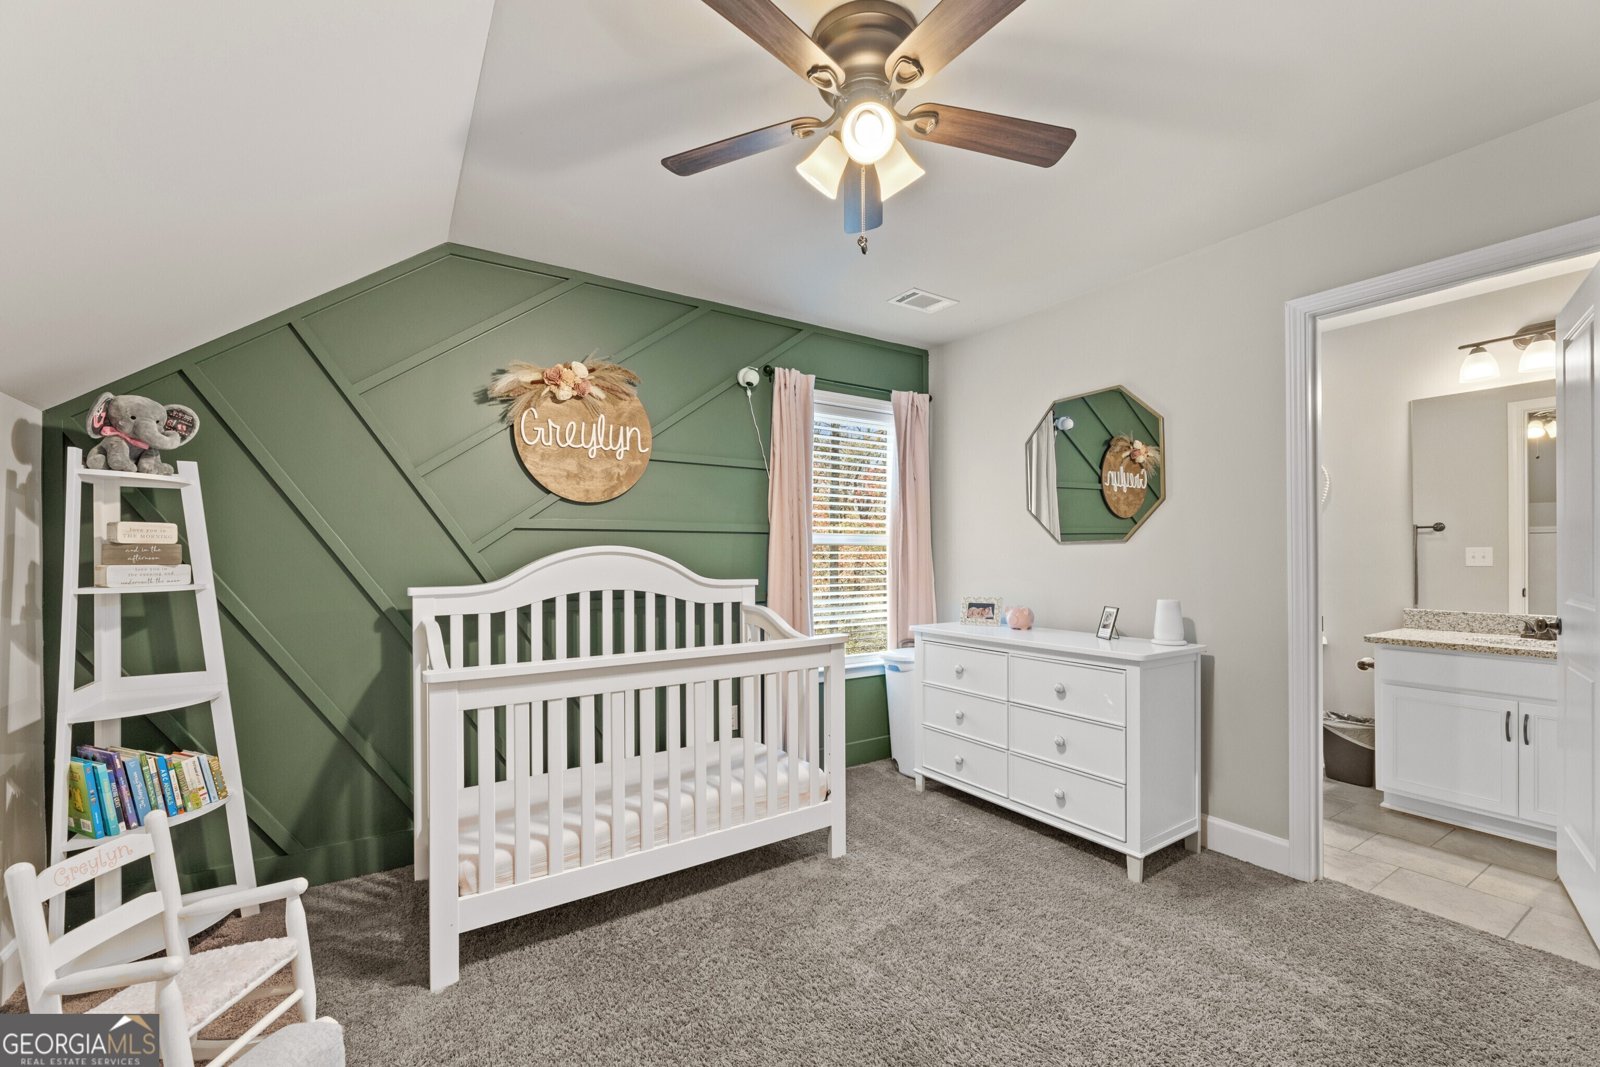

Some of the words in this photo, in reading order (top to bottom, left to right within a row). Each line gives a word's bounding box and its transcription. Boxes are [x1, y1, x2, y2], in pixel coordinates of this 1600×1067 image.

[521, 407, 649, 460] Greylyn
[127, 554, 160, 563] afternoon
[151, 545, 161, 553] the
[53, 843, 134, 887] Greylyn
